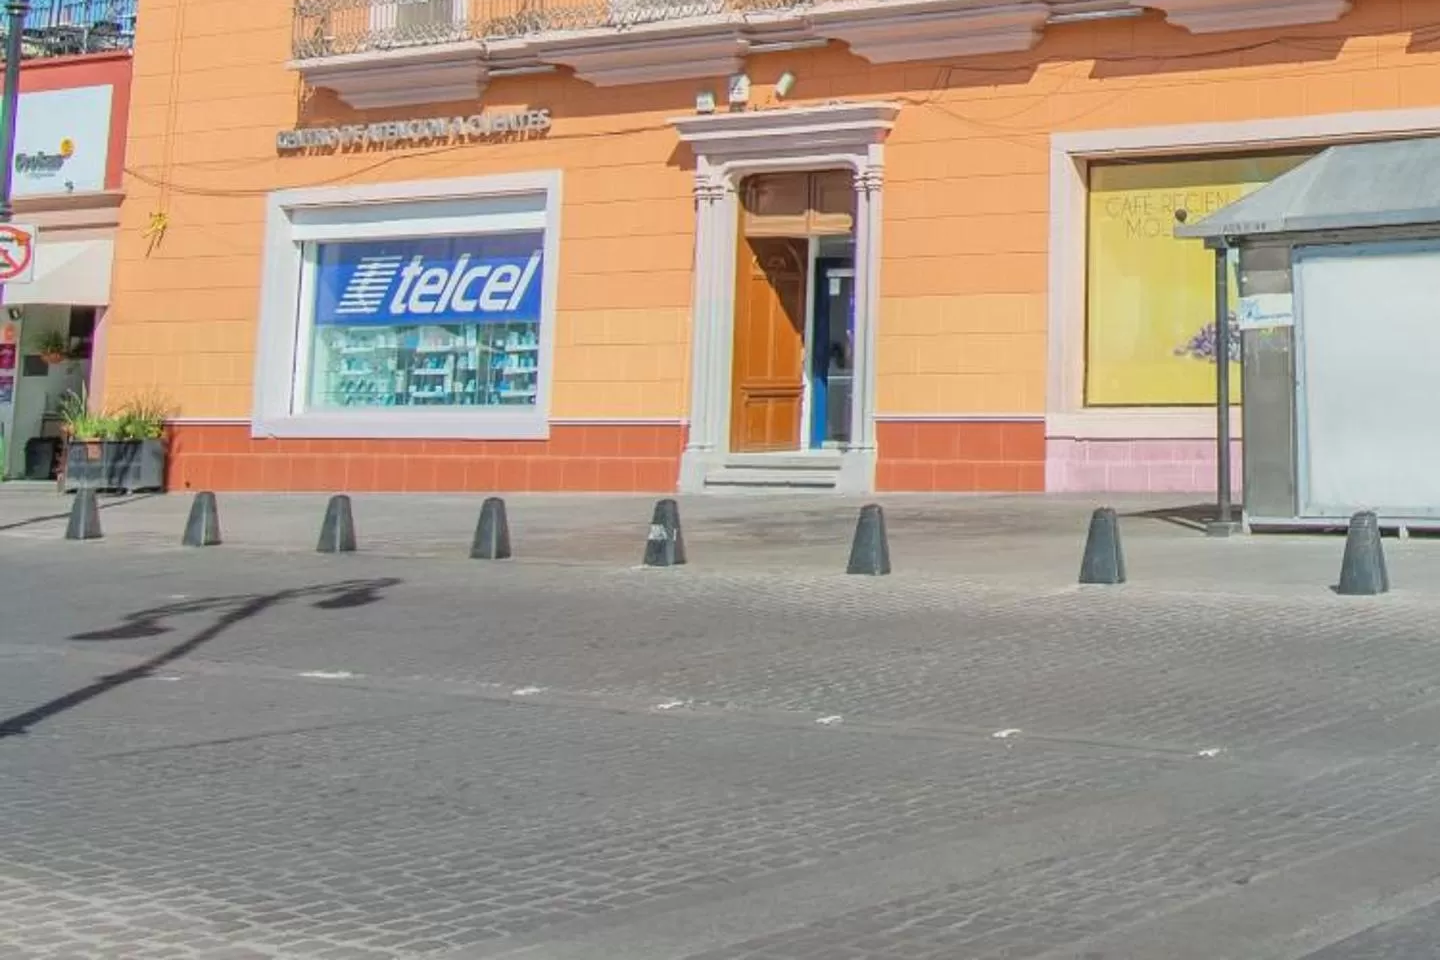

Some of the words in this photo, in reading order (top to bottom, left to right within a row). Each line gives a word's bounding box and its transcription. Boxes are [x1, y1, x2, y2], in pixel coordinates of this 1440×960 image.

[277, 128, 339, 148] CENTRO
[340, 125, 364, 143] DE
[449, 115, 462, 136] A
[463, 109, 551, 136] CLIENTES
[390, 249, 543, 314] telcel
